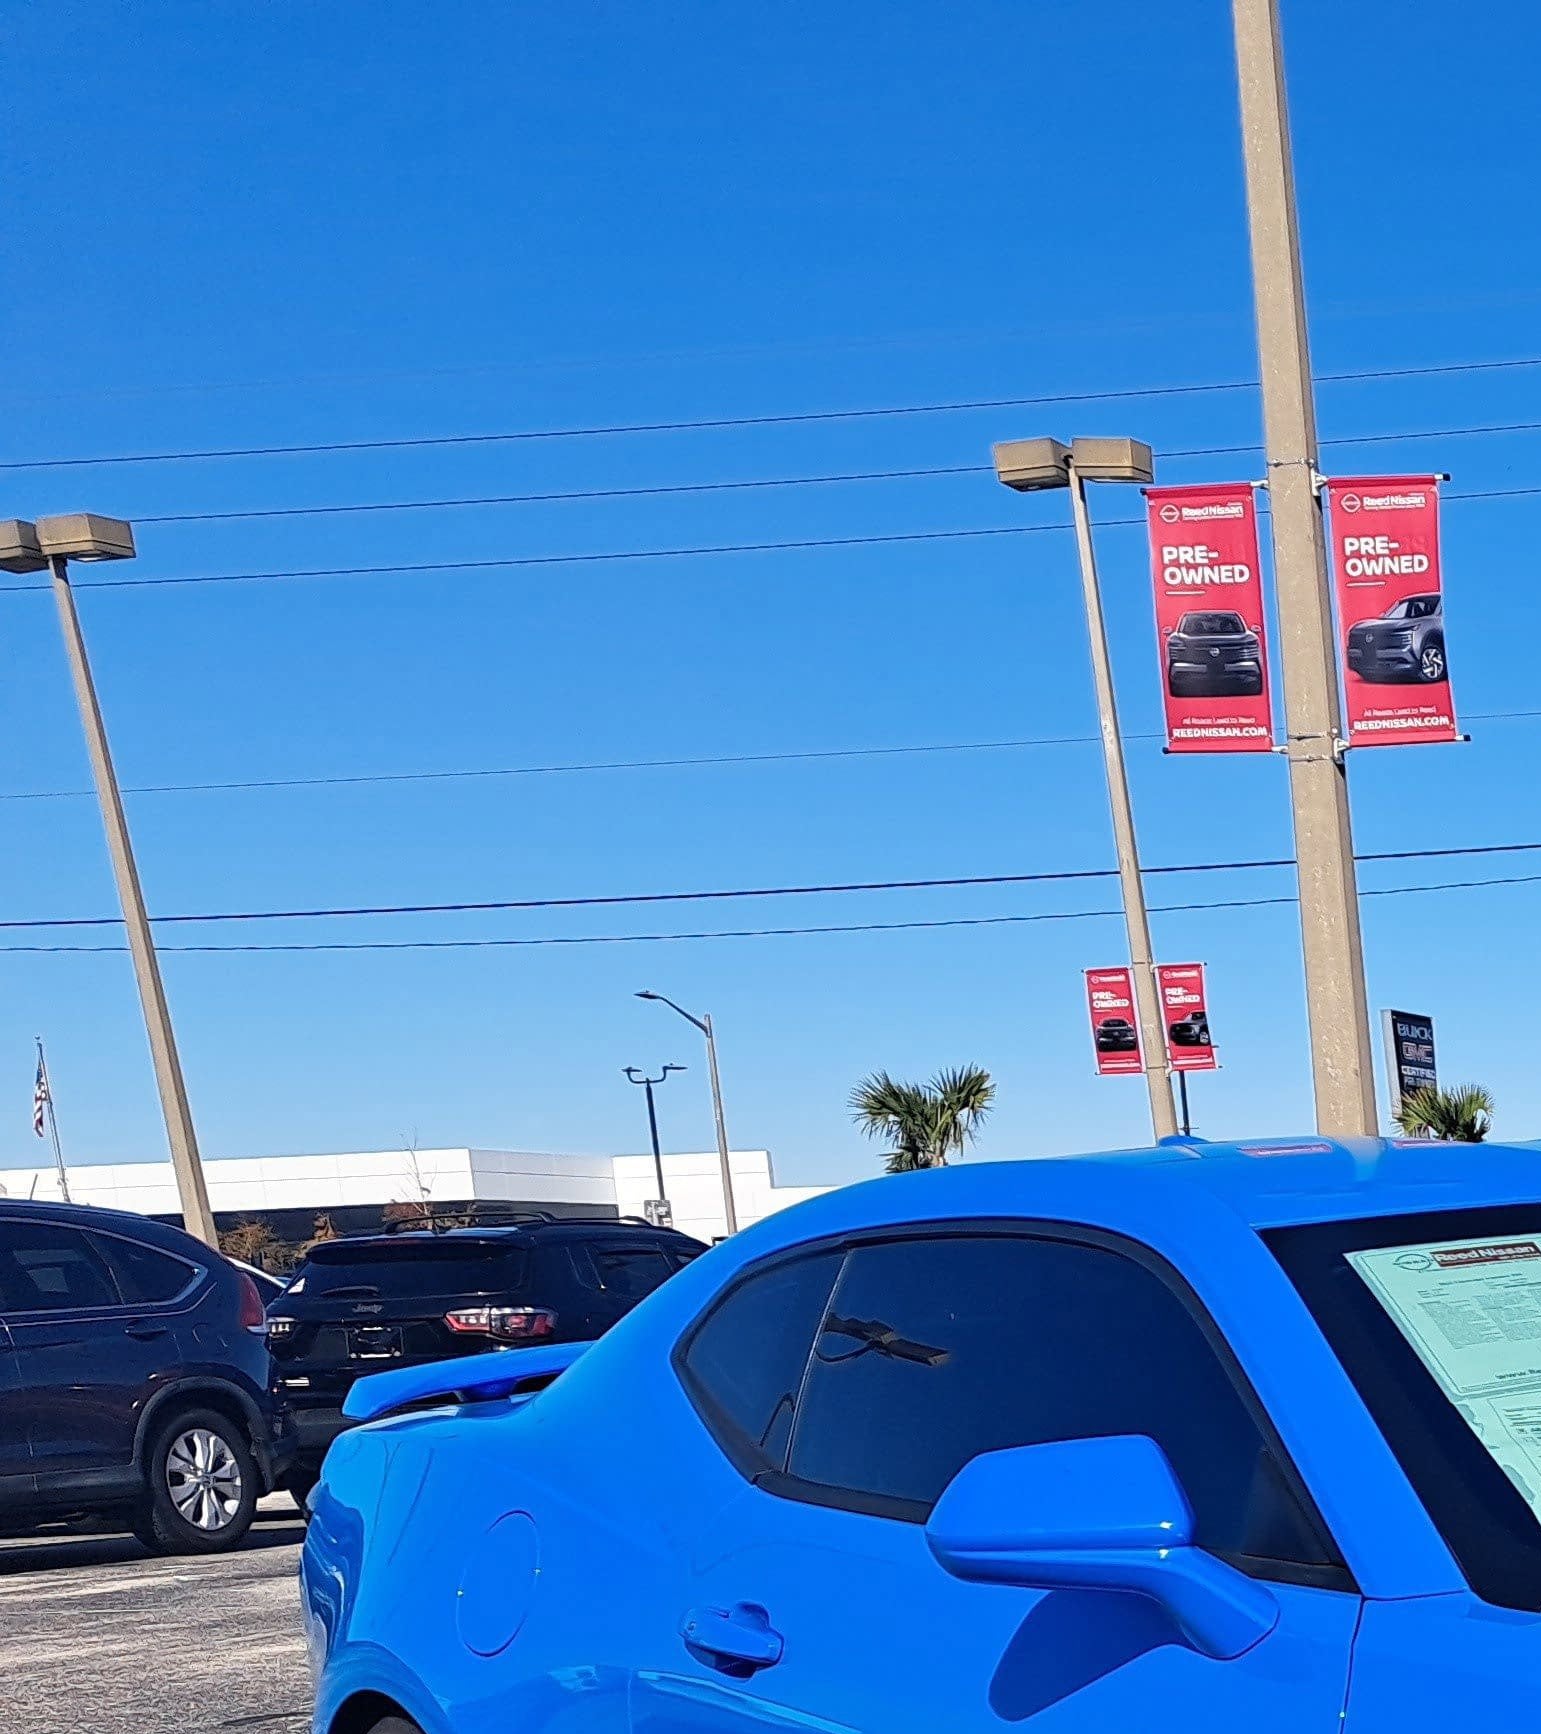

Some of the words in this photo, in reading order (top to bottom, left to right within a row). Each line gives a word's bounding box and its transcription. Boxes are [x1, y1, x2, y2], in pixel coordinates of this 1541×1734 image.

[1162, 545, 1219, 565] PRE-
[1344, 536, 1400, 556] PRE-
[1163, 564, 1250, 585] OWNED
[1345, 554, 1429, 577] OWNED
[1172, 727, 1268, 738] REEDNISSAN.COM
[1353, 716, 1450, 730] REEDNISSAN.COM
[1397, 1022, 1433, 1040] BUICK
[1402, 1041, 1433, 1063] GMC
[1434, 1249, 1480, 1262] Reed
[1479, 1245, 1535, 1258] Nissan
